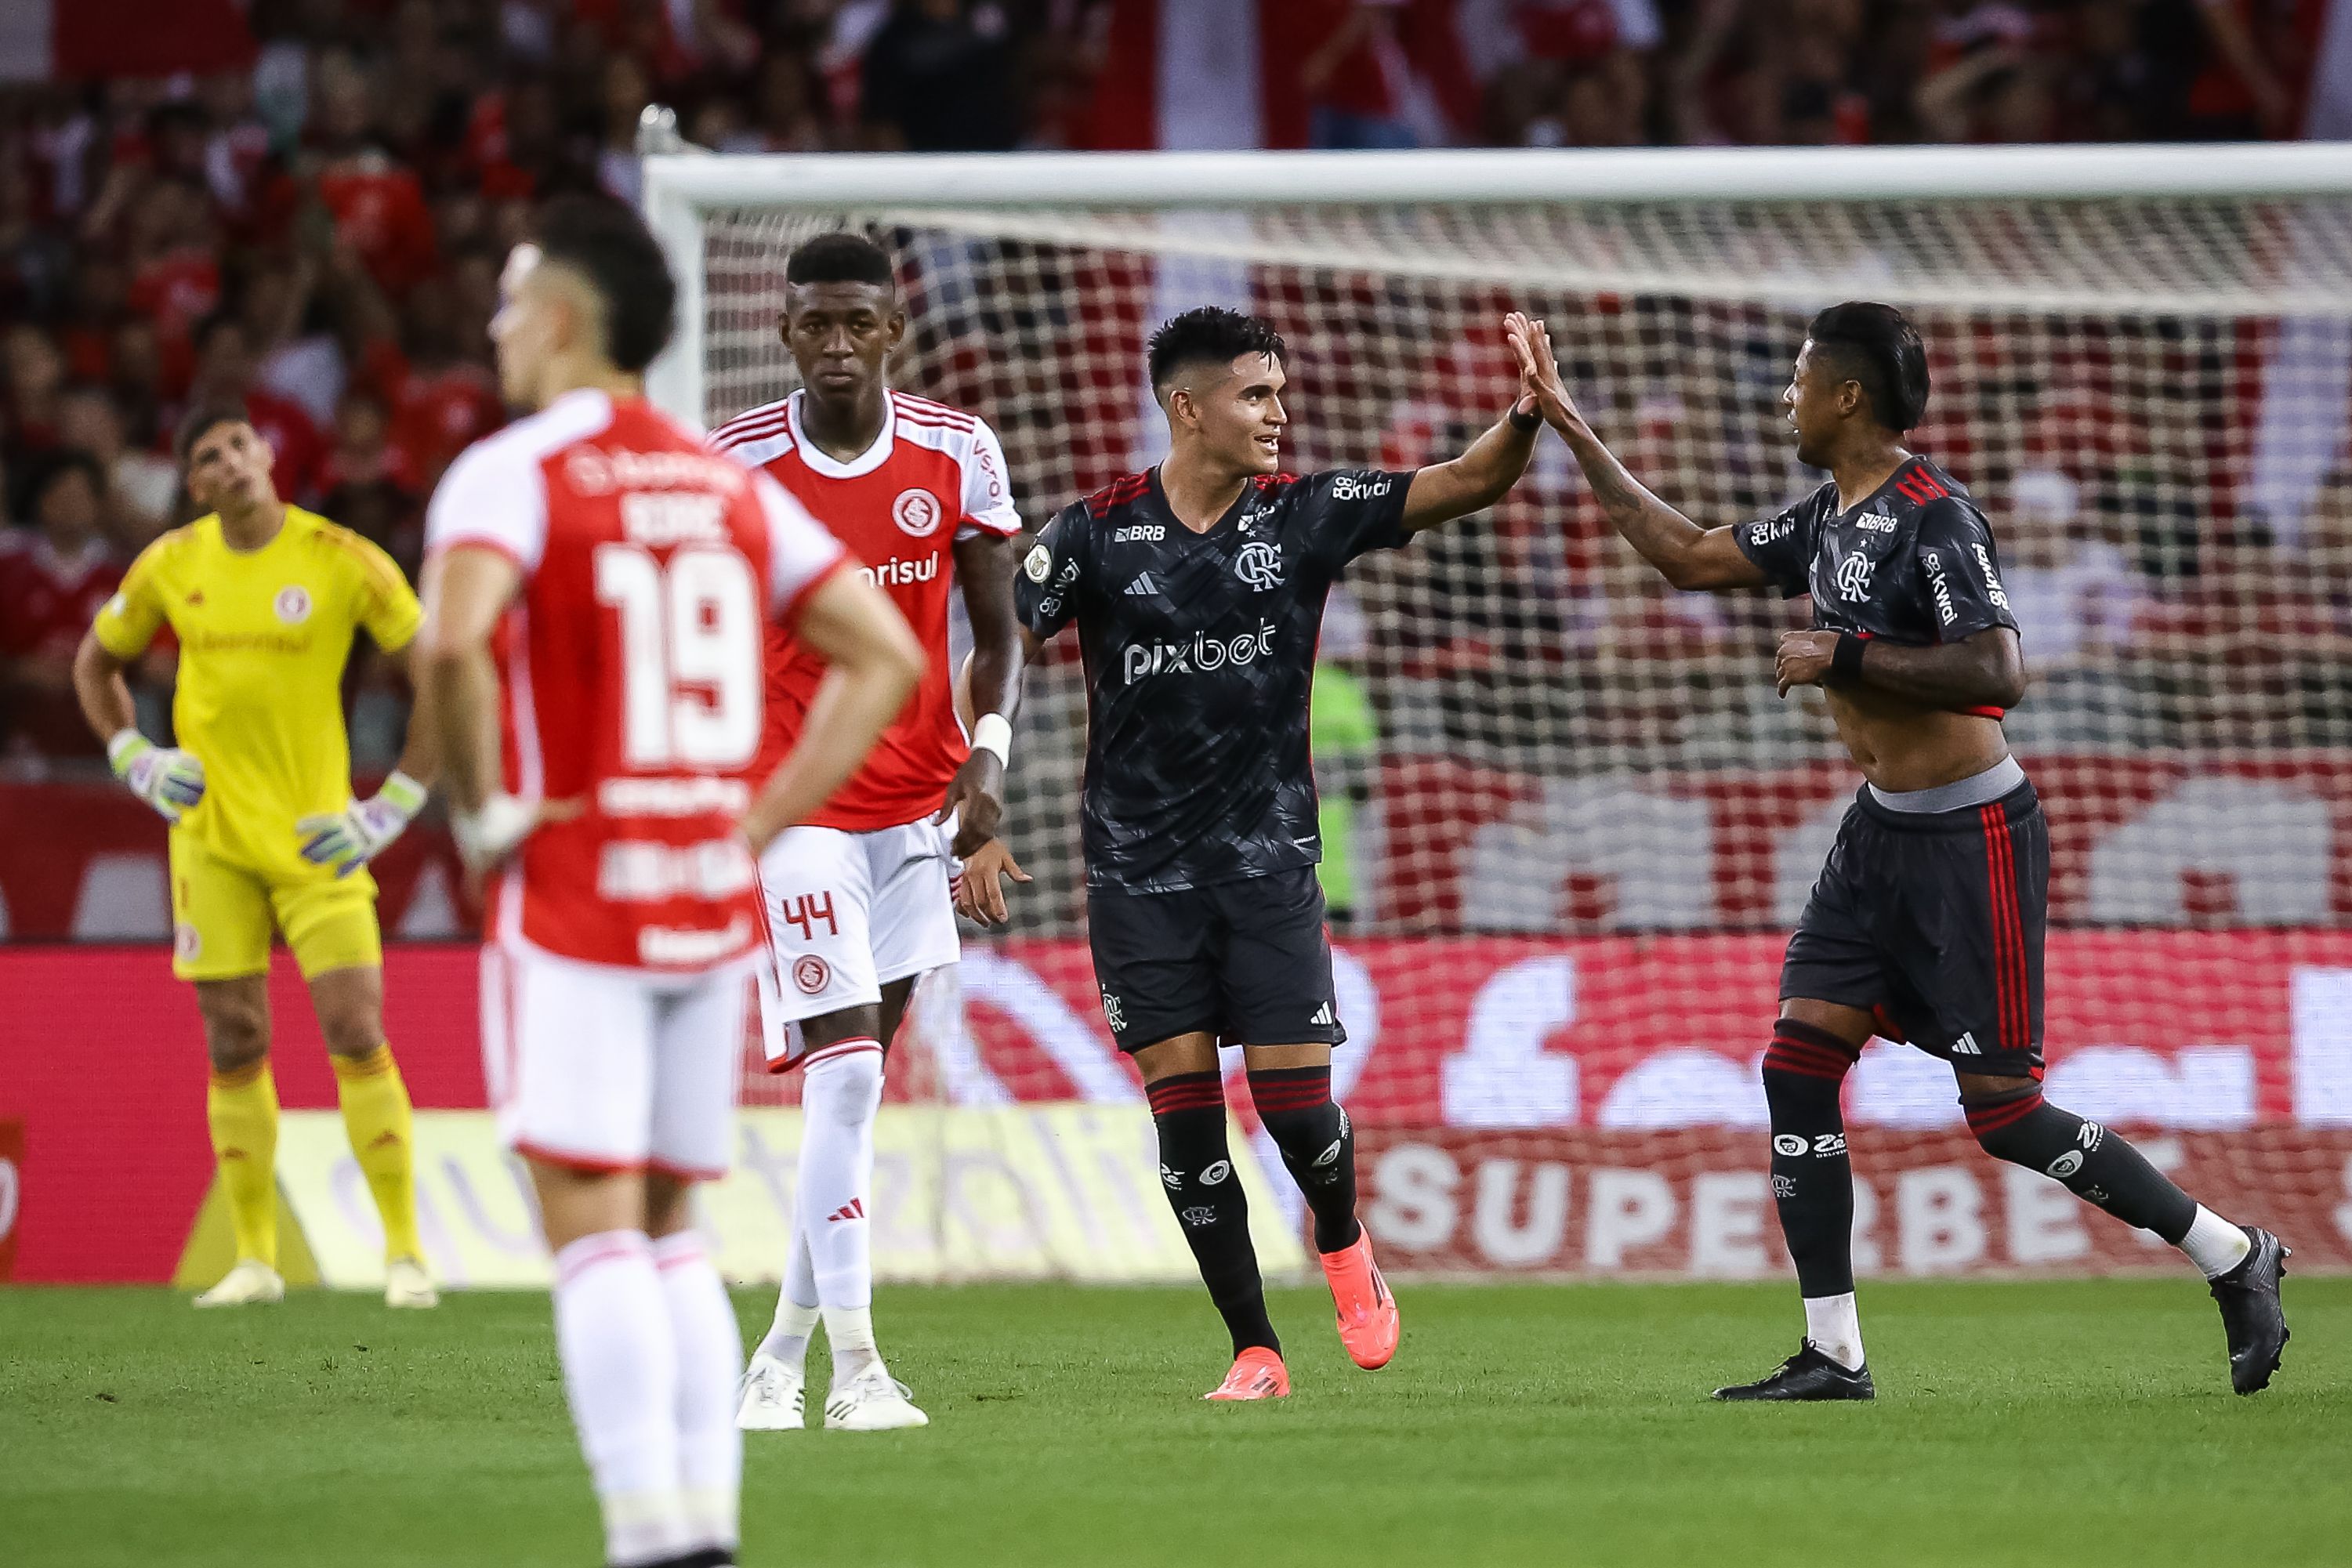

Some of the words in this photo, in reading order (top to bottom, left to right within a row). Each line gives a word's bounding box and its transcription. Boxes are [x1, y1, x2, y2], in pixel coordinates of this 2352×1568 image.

[1130, 525, 1165, 541] BRB
[1868, 514, 1897, 533] BRB
[860, 550, 939, 588] nrisul
[1932, 572, 1958, 626] kwai
[596, 542, 763, 763] 19
[1124, 617, 1277, 686] pixbet
[781, 890, 839, 940] 44
